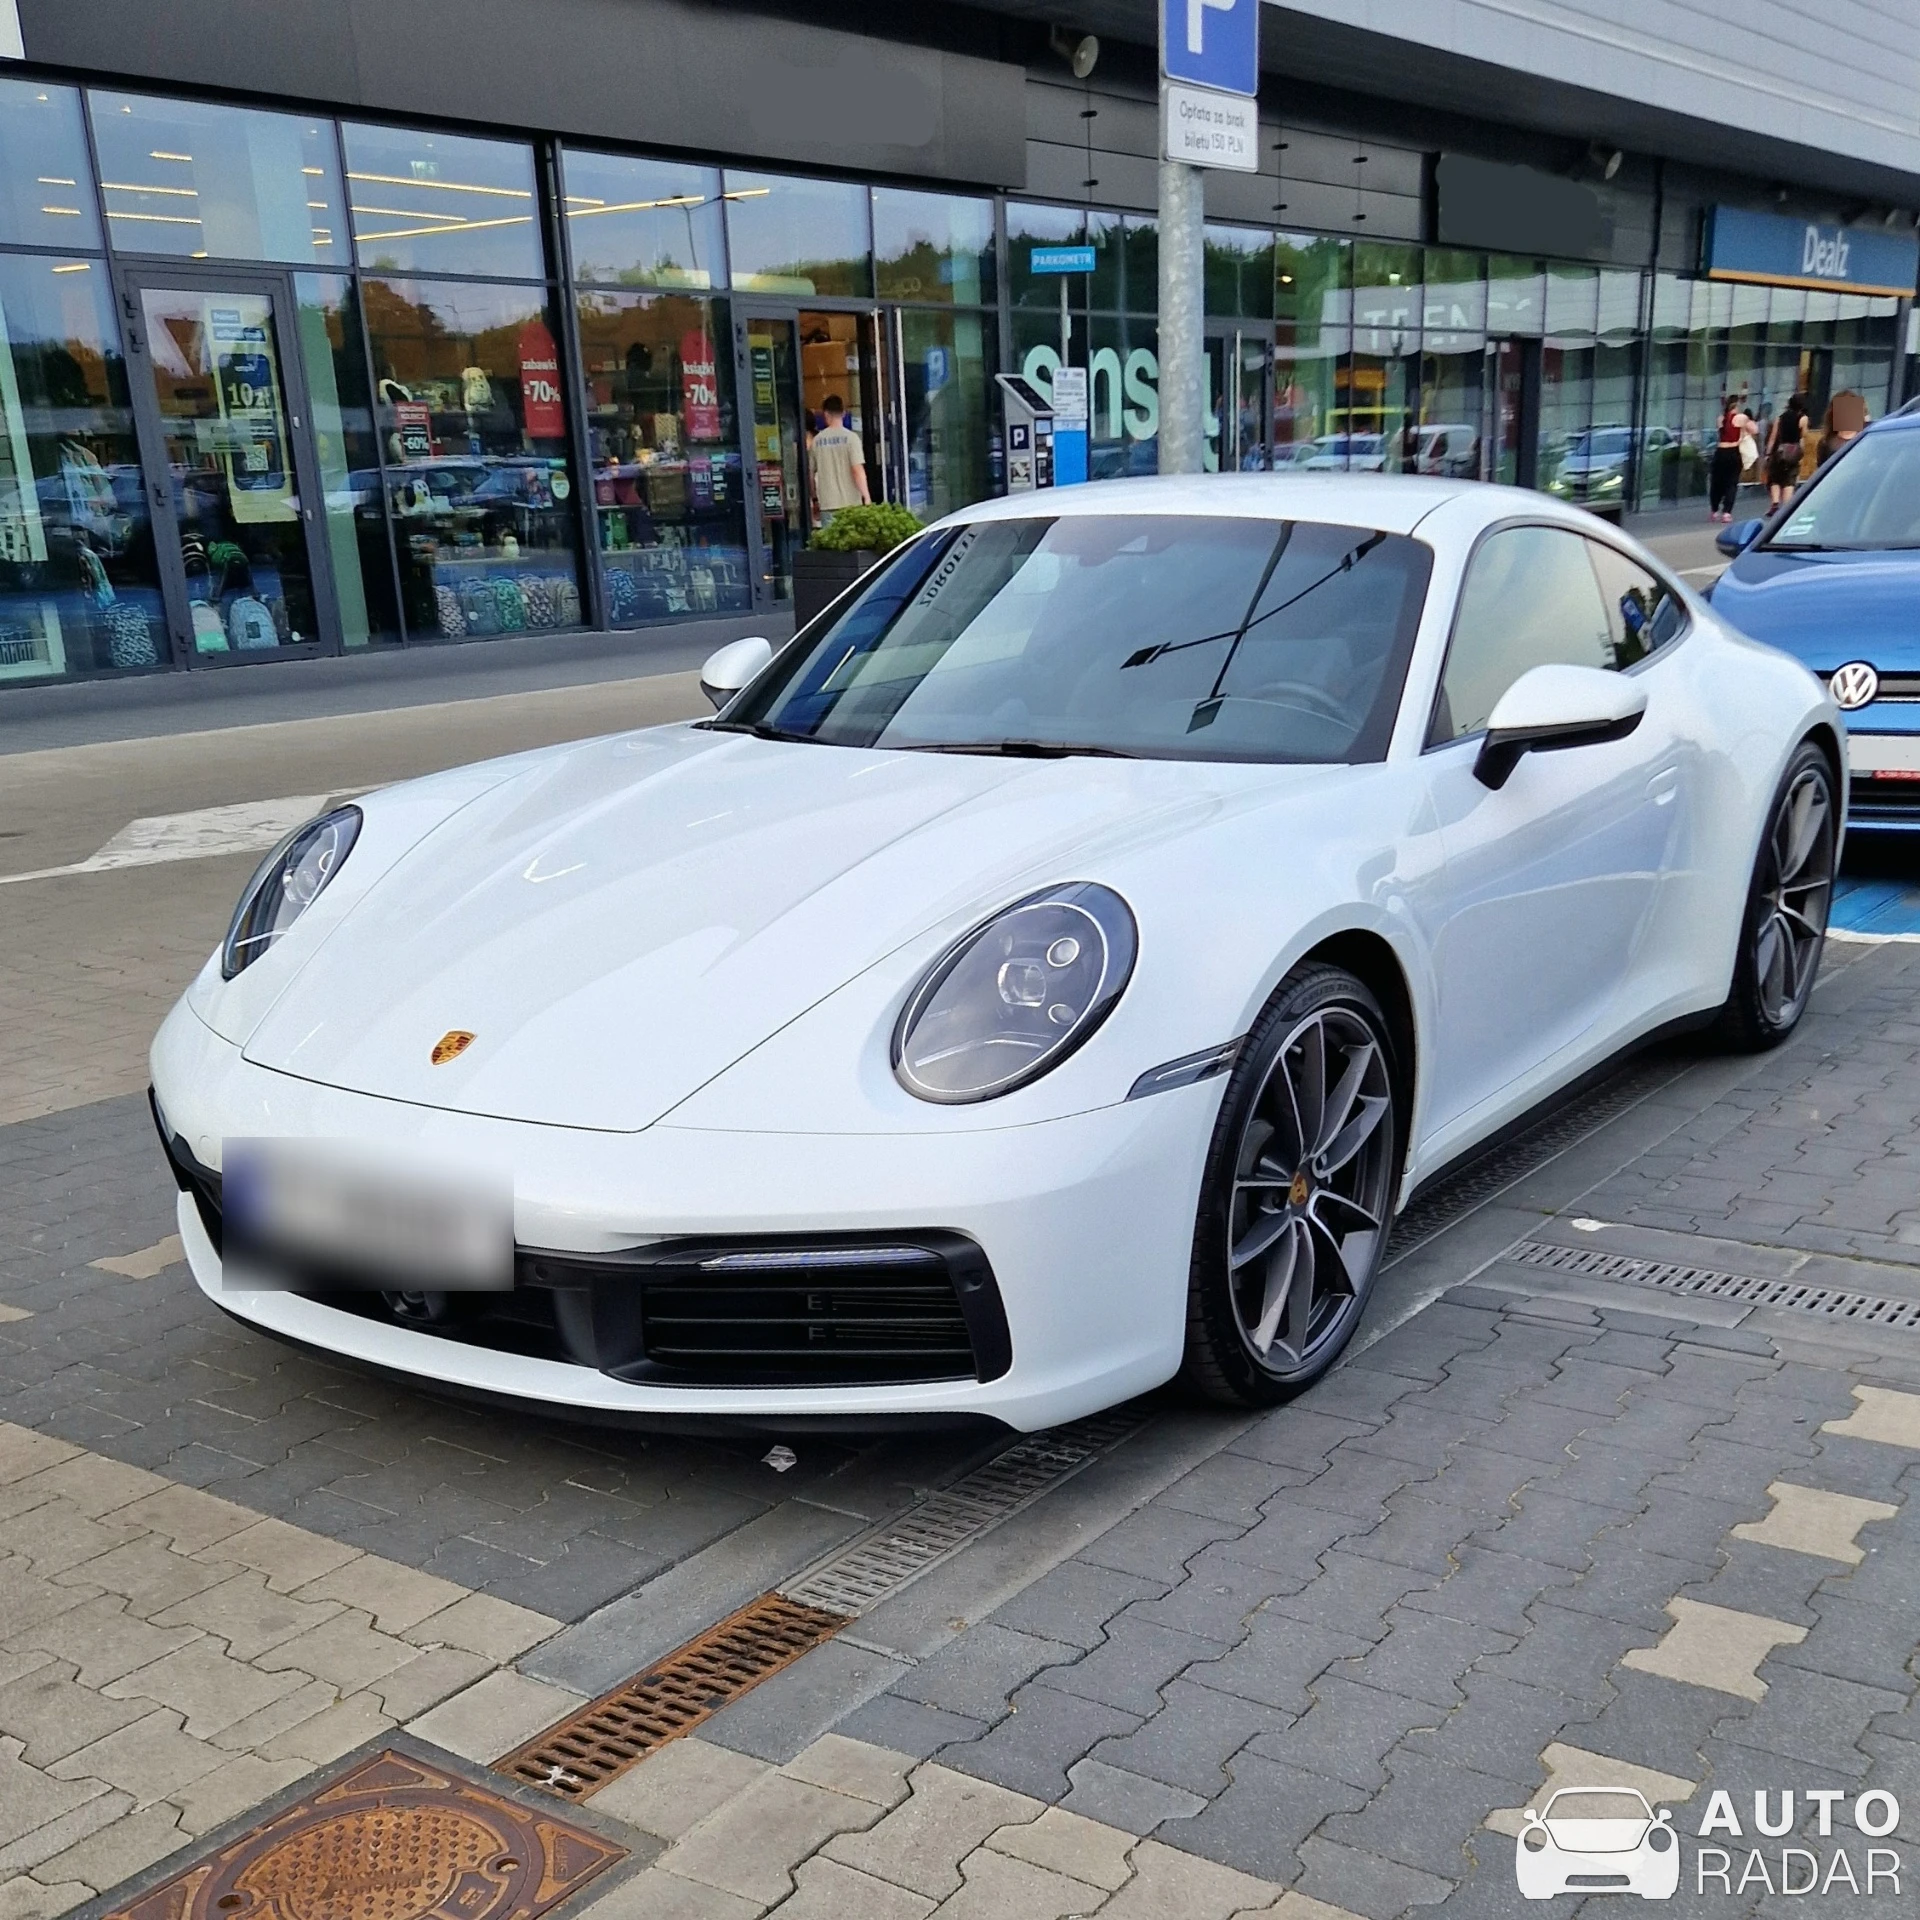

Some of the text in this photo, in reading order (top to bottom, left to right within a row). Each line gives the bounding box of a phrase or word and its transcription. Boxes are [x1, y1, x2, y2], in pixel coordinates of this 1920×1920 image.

[1179, 100, 1245, 127] Opłata za brak
[1184, 130, 1244, 154] biletu 150 PLN
[1032, 251, 1093, 267] PARKOMETR
[1802, 224, 1850, 278] Dealz
[521, 358, 557, 371] zabawki
[523, 380, 561, 402] -70%
[685, 383, 717, 405] -70%
